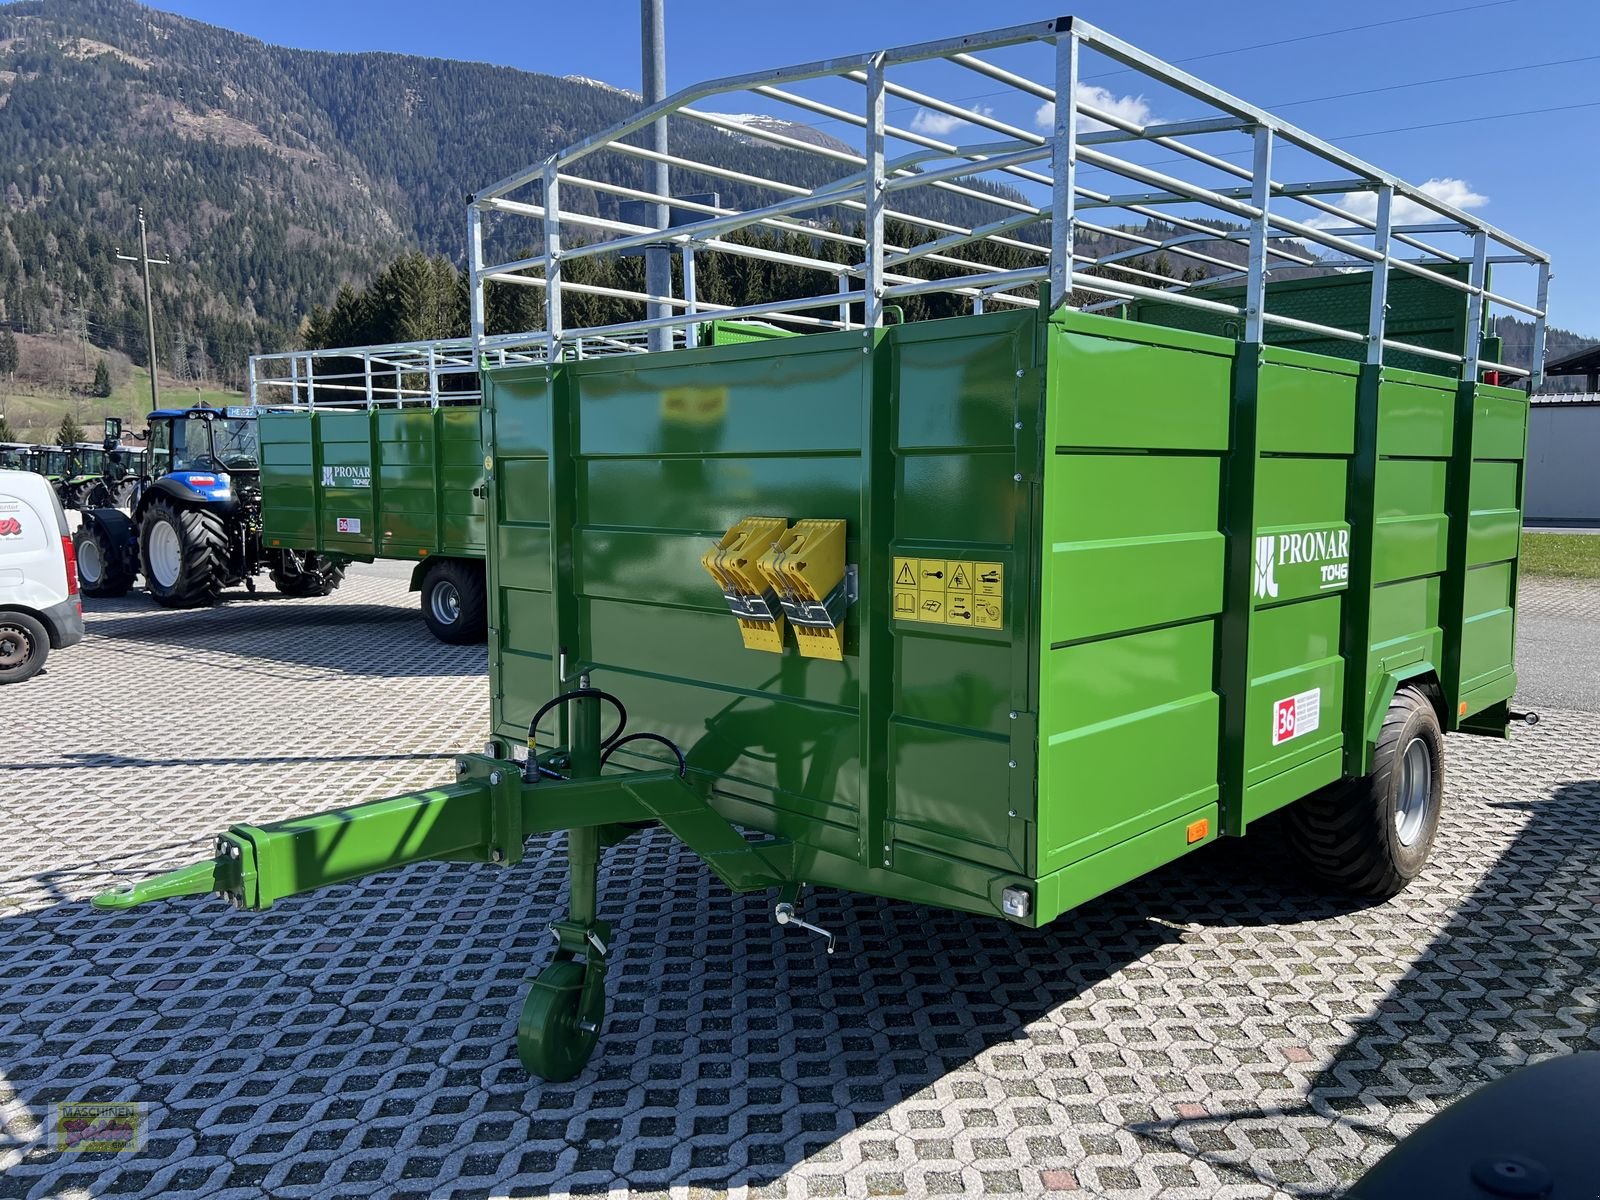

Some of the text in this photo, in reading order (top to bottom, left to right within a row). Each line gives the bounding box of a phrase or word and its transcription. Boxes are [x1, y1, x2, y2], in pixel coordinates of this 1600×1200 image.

[334, 466, 370, 478] PRONAR
[340, 520, 347, 530] 36
[1278, 529, 1348, 565] PRONAR
[1279, 705, 1295, 735] 36
